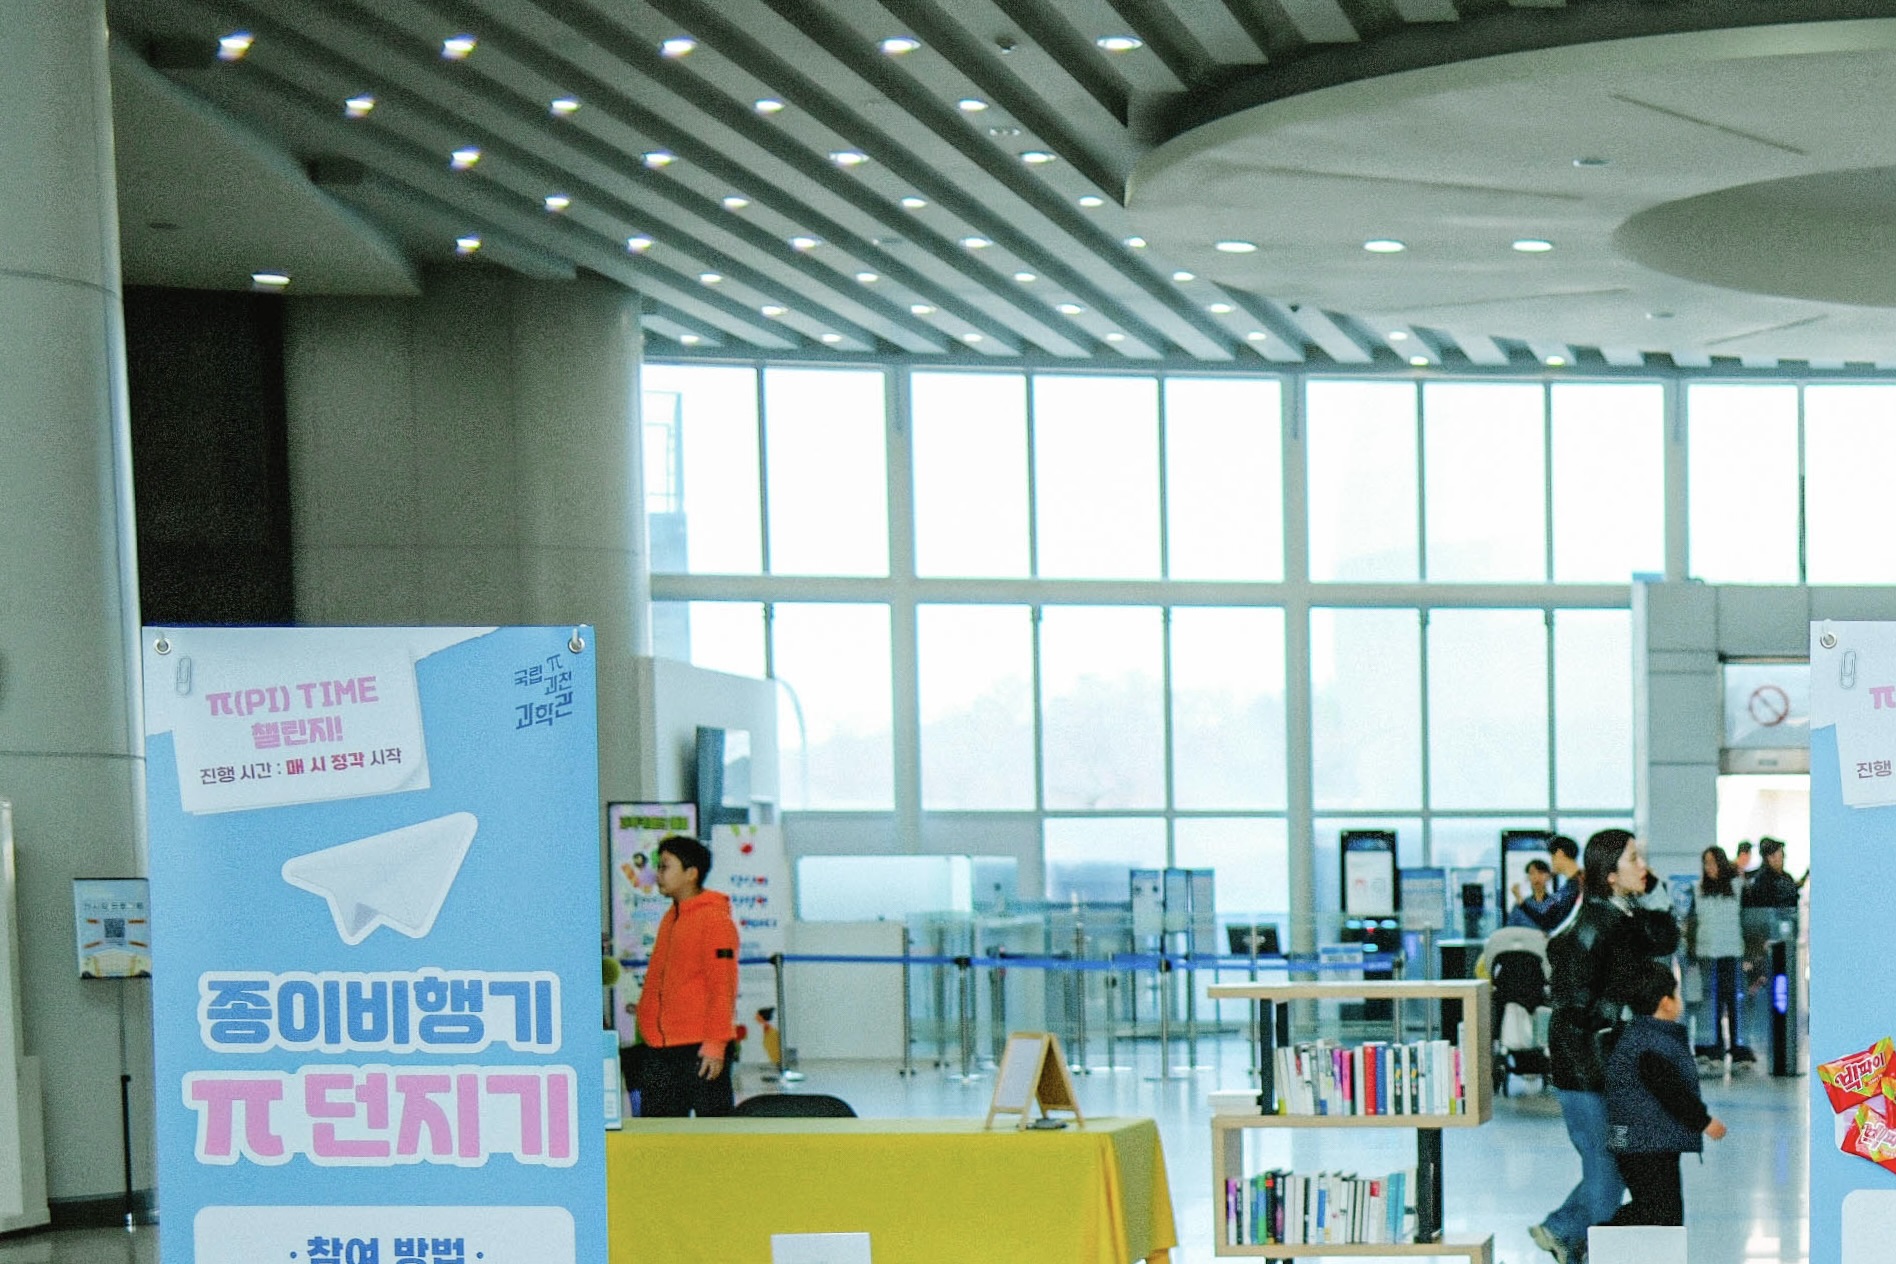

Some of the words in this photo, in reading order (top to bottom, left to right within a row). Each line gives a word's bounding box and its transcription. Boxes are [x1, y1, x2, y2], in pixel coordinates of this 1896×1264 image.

[514, 664, 543, 687] 국립
[205, 686, 290, 716] π(PI)
[296, 676, 379, 708] TIME
[515, 691, 573, 730] 과학관
[251, 716, 343, 749] 챌린지!
[201, 766, 235, 785] 진행
[241, 762, 271, 780] 시간
[287, 759, 304, 774] 매
[311, 756, 326, 772] 시
[331, 752, 364, 770] 정각
[371, 748, 401, 765] 시작
[1857, 760, 1892, 779] 진행
[207, 978, 553, 1045] 종이비행기
[1835, 1052, 1886, 1093] 빅파이
[191, 1079, 283, 1156] π
[304, 1073, 570, 1159] 던지기
